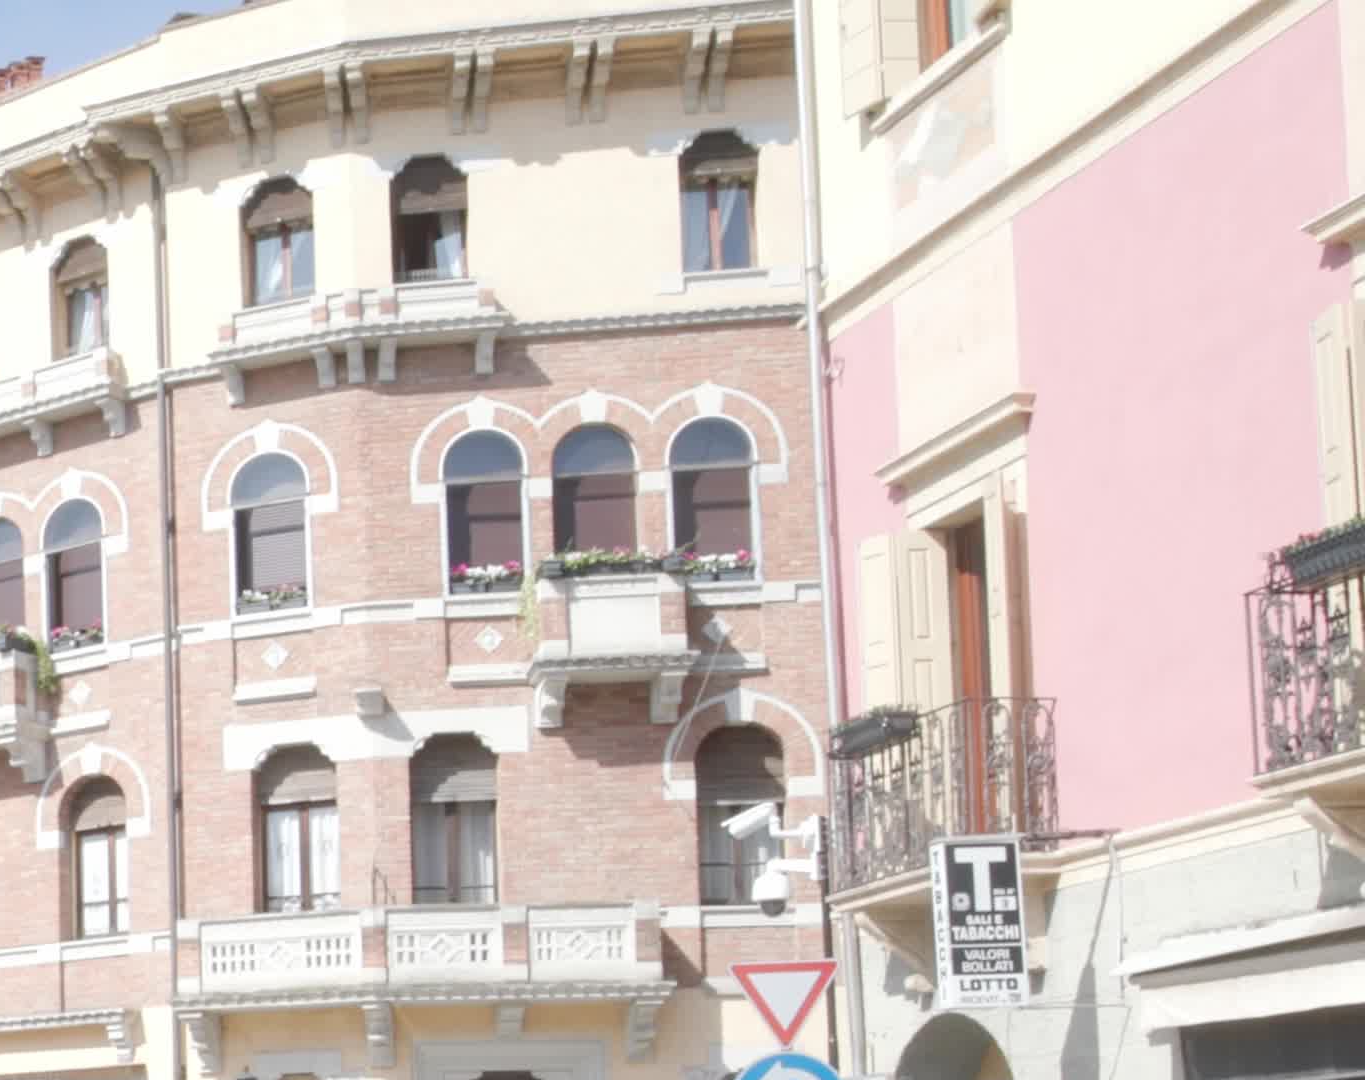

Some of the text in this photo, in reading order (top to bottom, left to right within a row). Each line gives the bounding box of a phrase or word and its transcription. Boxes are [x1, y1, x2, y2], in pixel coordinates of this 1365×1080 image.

[953, 846, 1007, 912] T
[952, 925, 1019, 941] TABACCHI
[964, 948, 1010, 961] VALORI
[961, 960, 1014, 973] BOLLATI
[959, 978, 1018, 992] LOTTO
